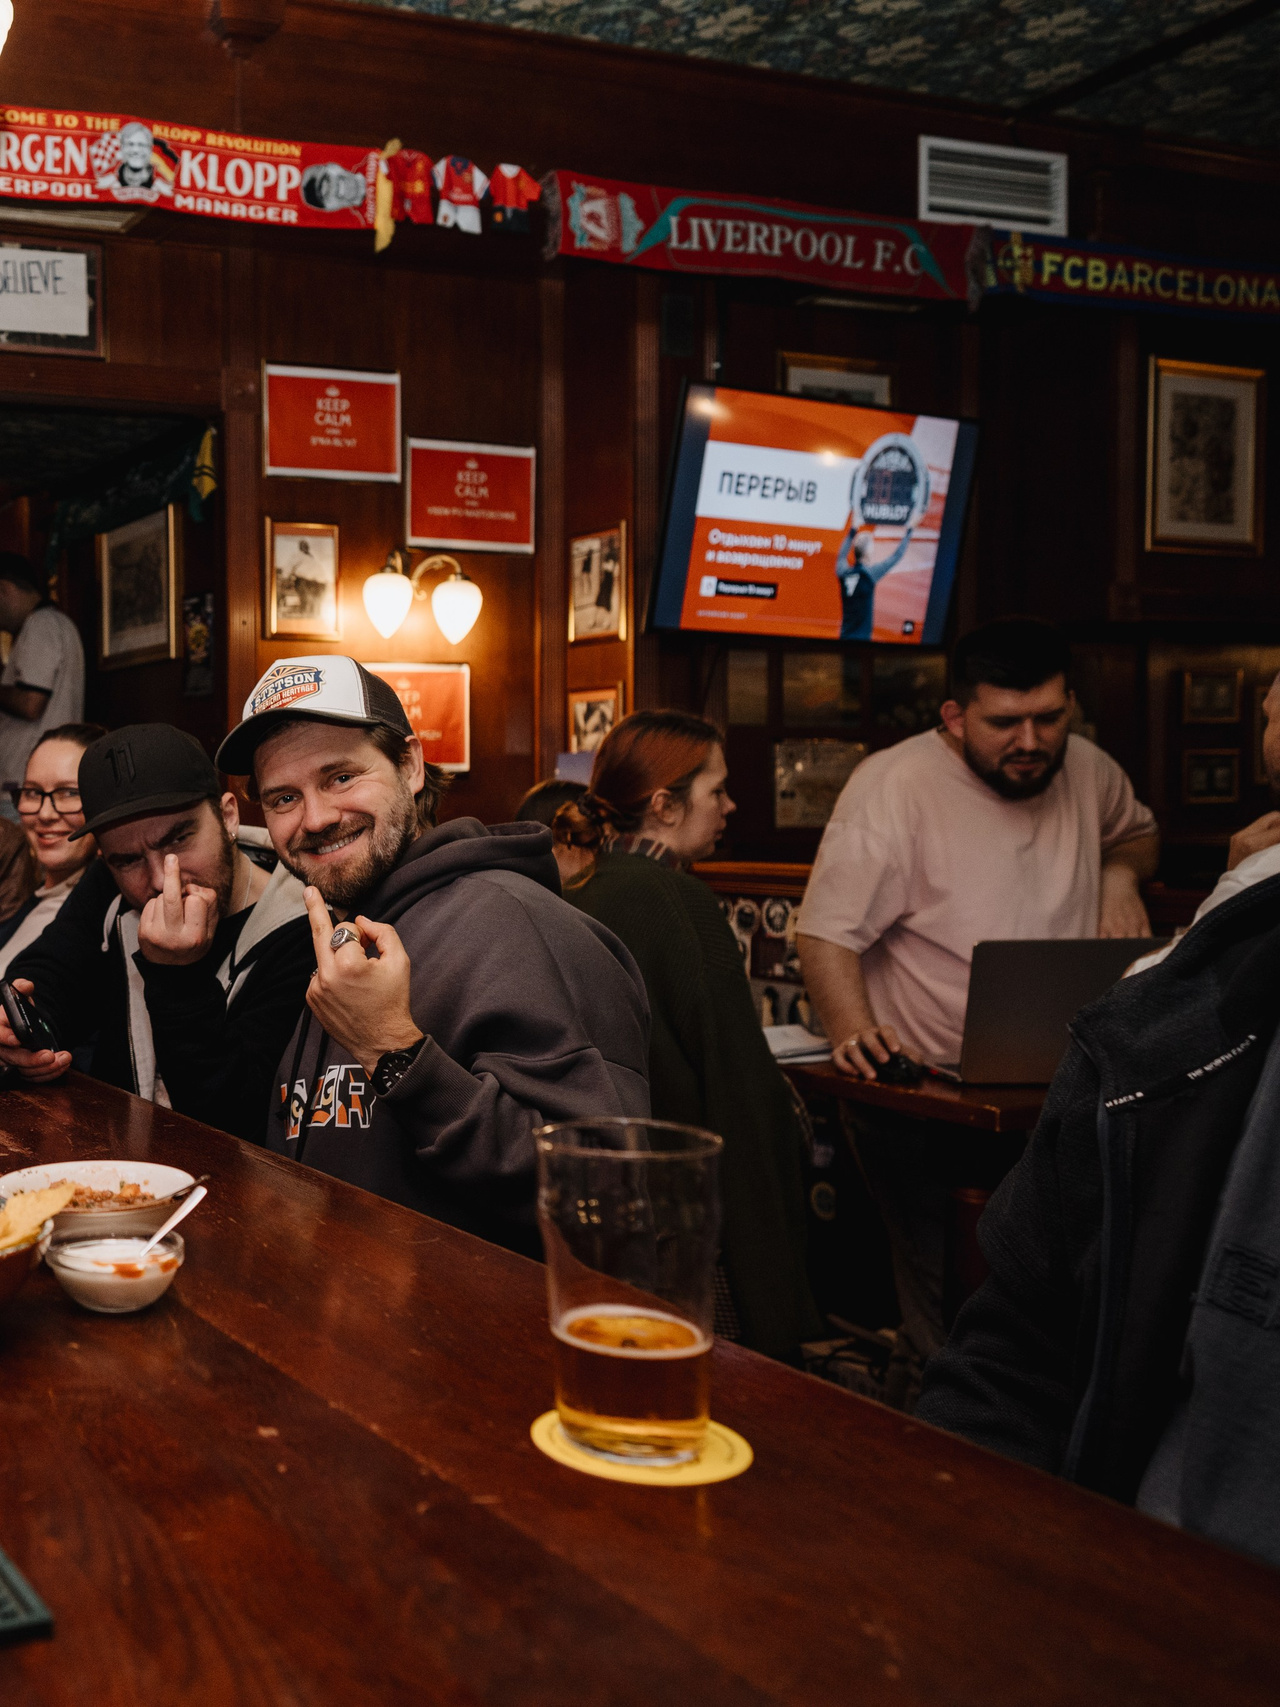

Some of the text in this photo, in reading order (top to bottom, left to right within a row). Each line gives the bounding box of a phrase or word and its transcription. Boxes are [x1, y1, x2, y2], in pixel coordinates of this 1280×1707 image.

[53, 113, 79, 130] TO
[84, 116, 120, 132] THE
[152, 123, 202, 144] KLOPP
[205, 133, 302, 159] REVOLUTION
[178, 149, 302, 203] KLOPP
[173, 193, 298, 225] MANAGER
[668, 214, 864, 271] LIVERPOOL
[316, 398, 351, 412] KEEP
[313, 412, 352, 427] CALM
[456, 471, 488, 485] KEEP
[719, 471, 818, 503] ПЕРЕРЫВ
[454, 484, 489, 498] CALM
[708, 529, 771, 549] Отдыхаем
[773, 534, 786, 550] 10
[254, 672, 316, 707] STETSON
[282, 683, 315, 699] HERITAGE
[1186, 1068, 1204, 1080] THE
